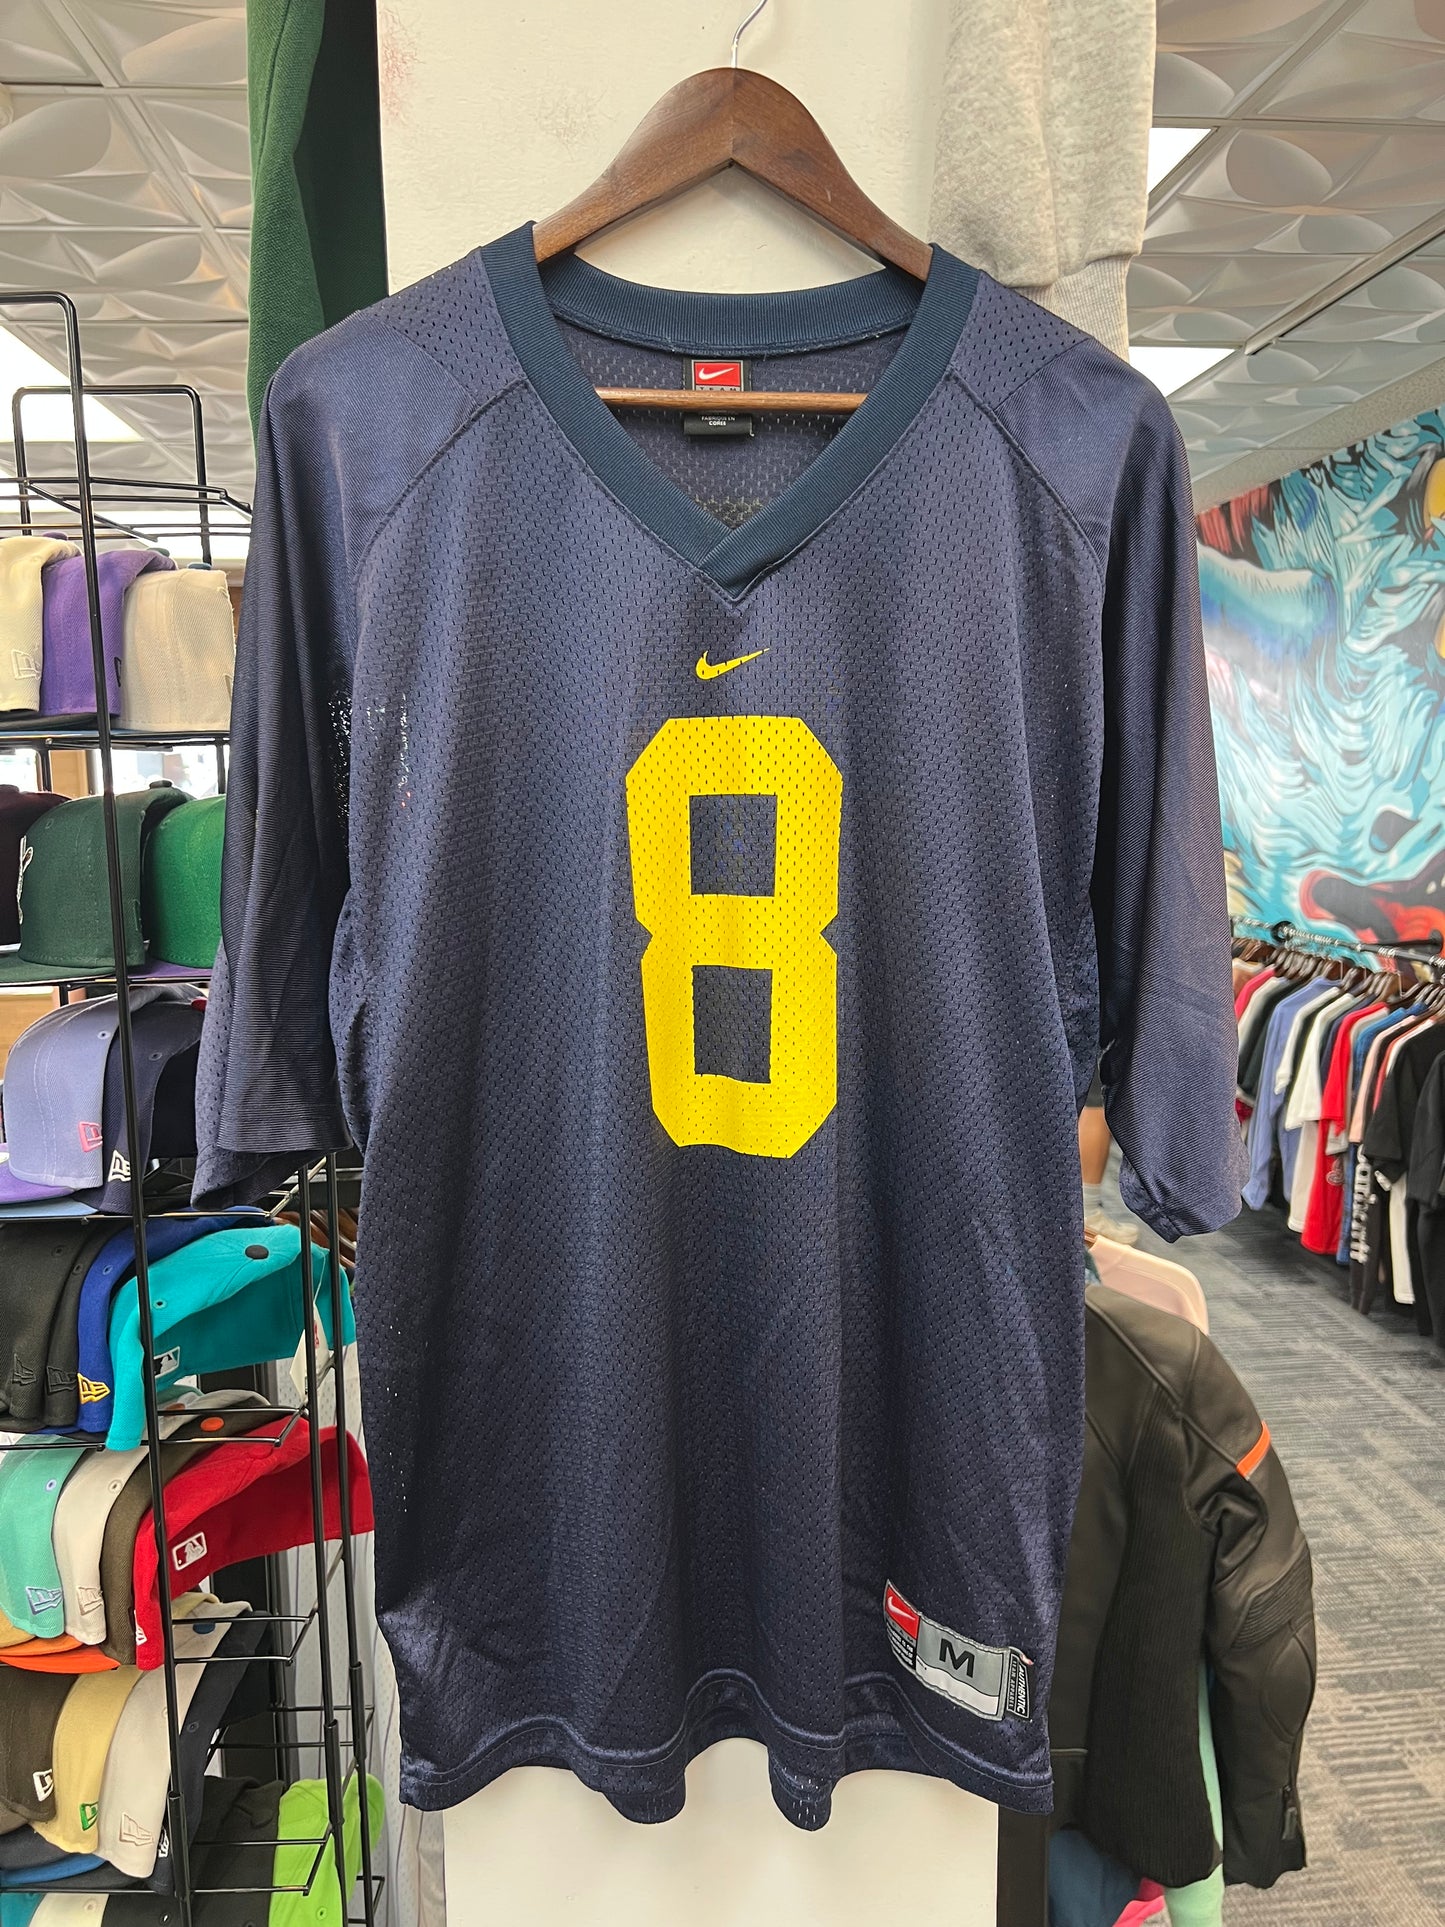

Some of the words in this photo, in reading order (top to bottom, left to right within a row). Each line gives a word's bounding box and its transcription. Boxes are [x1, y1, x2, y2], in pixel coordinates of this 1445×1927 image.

[626, 715, 843, 1158] 8
[939, 1638, 975, 1678] M
[1016, 1665, 1026, 1714] AUTHENTIC
